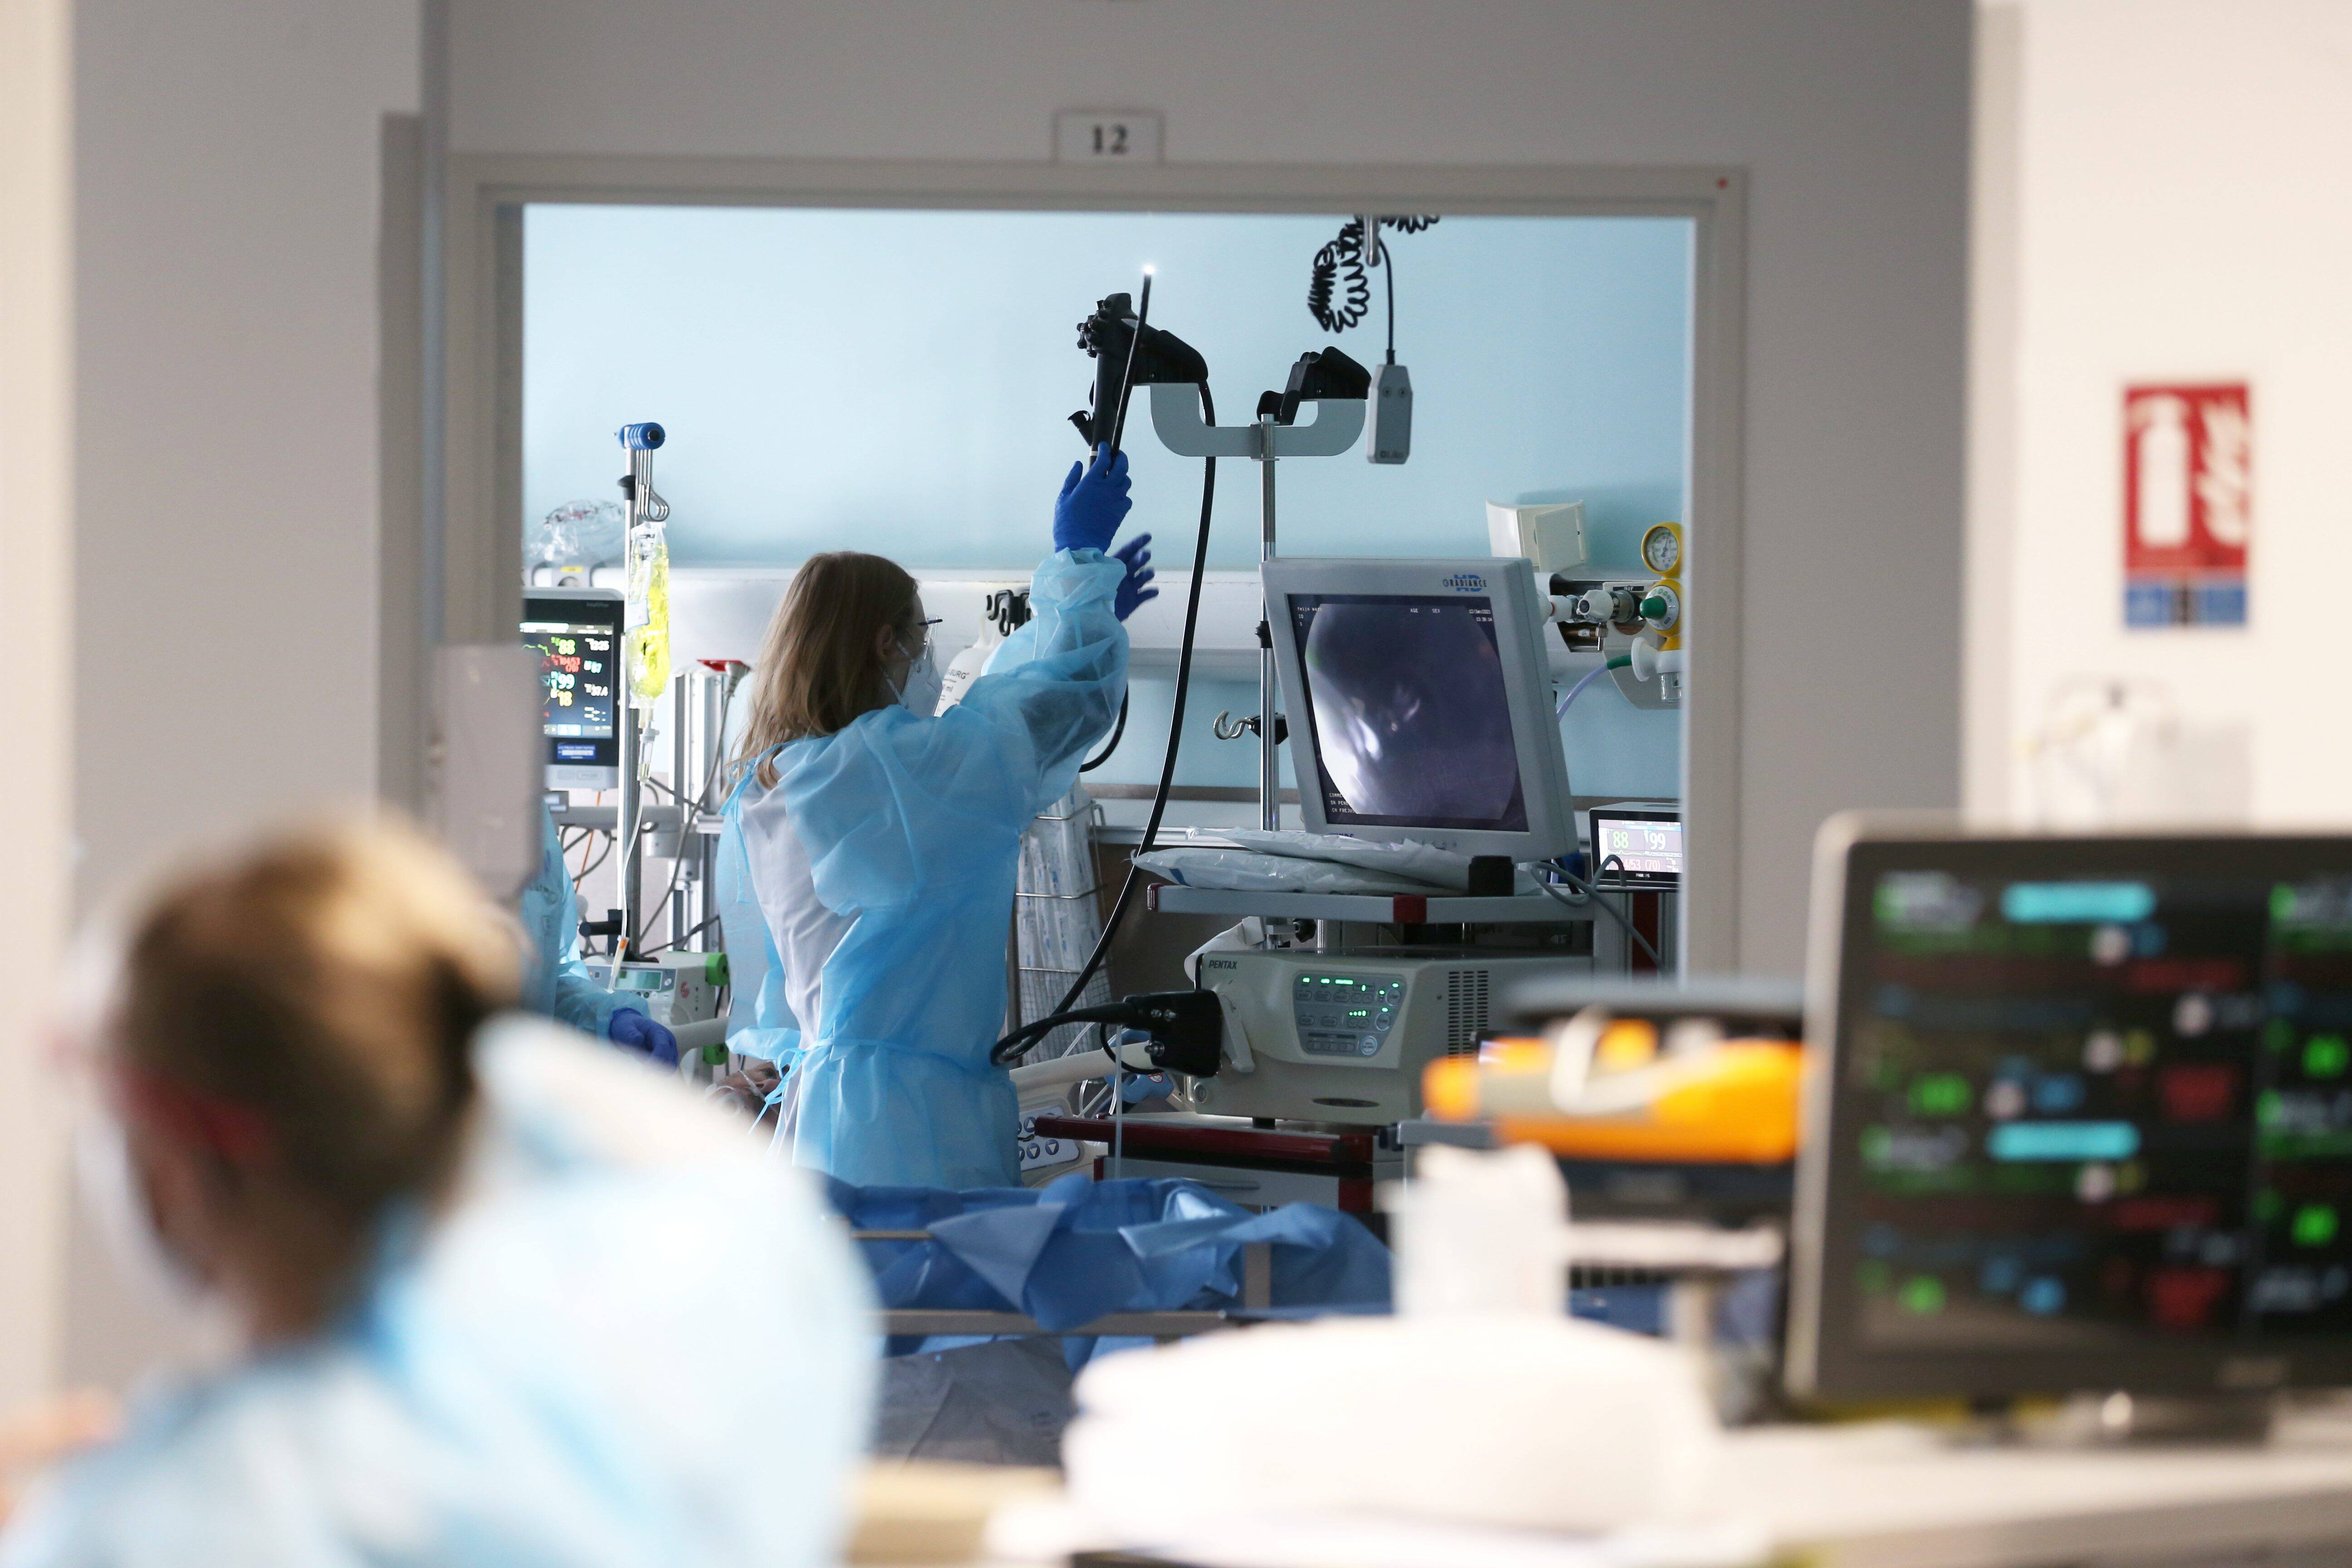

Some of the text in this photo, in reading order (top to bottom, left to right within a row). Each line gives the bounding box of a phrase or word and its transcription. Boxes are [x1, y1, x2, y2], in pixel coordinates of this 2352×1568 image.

[1094, 124, 1128, 153] 12
[1450, 579, 1487, 587] RADIANCE
[559, 639, 575, 655] 88
[558, 674, 575, 689] 99
[1612, 831, 1629, 849] 88
[1649, 832, 1666, 850] 99
[1209, 960, 1237, 969] PENTAX
